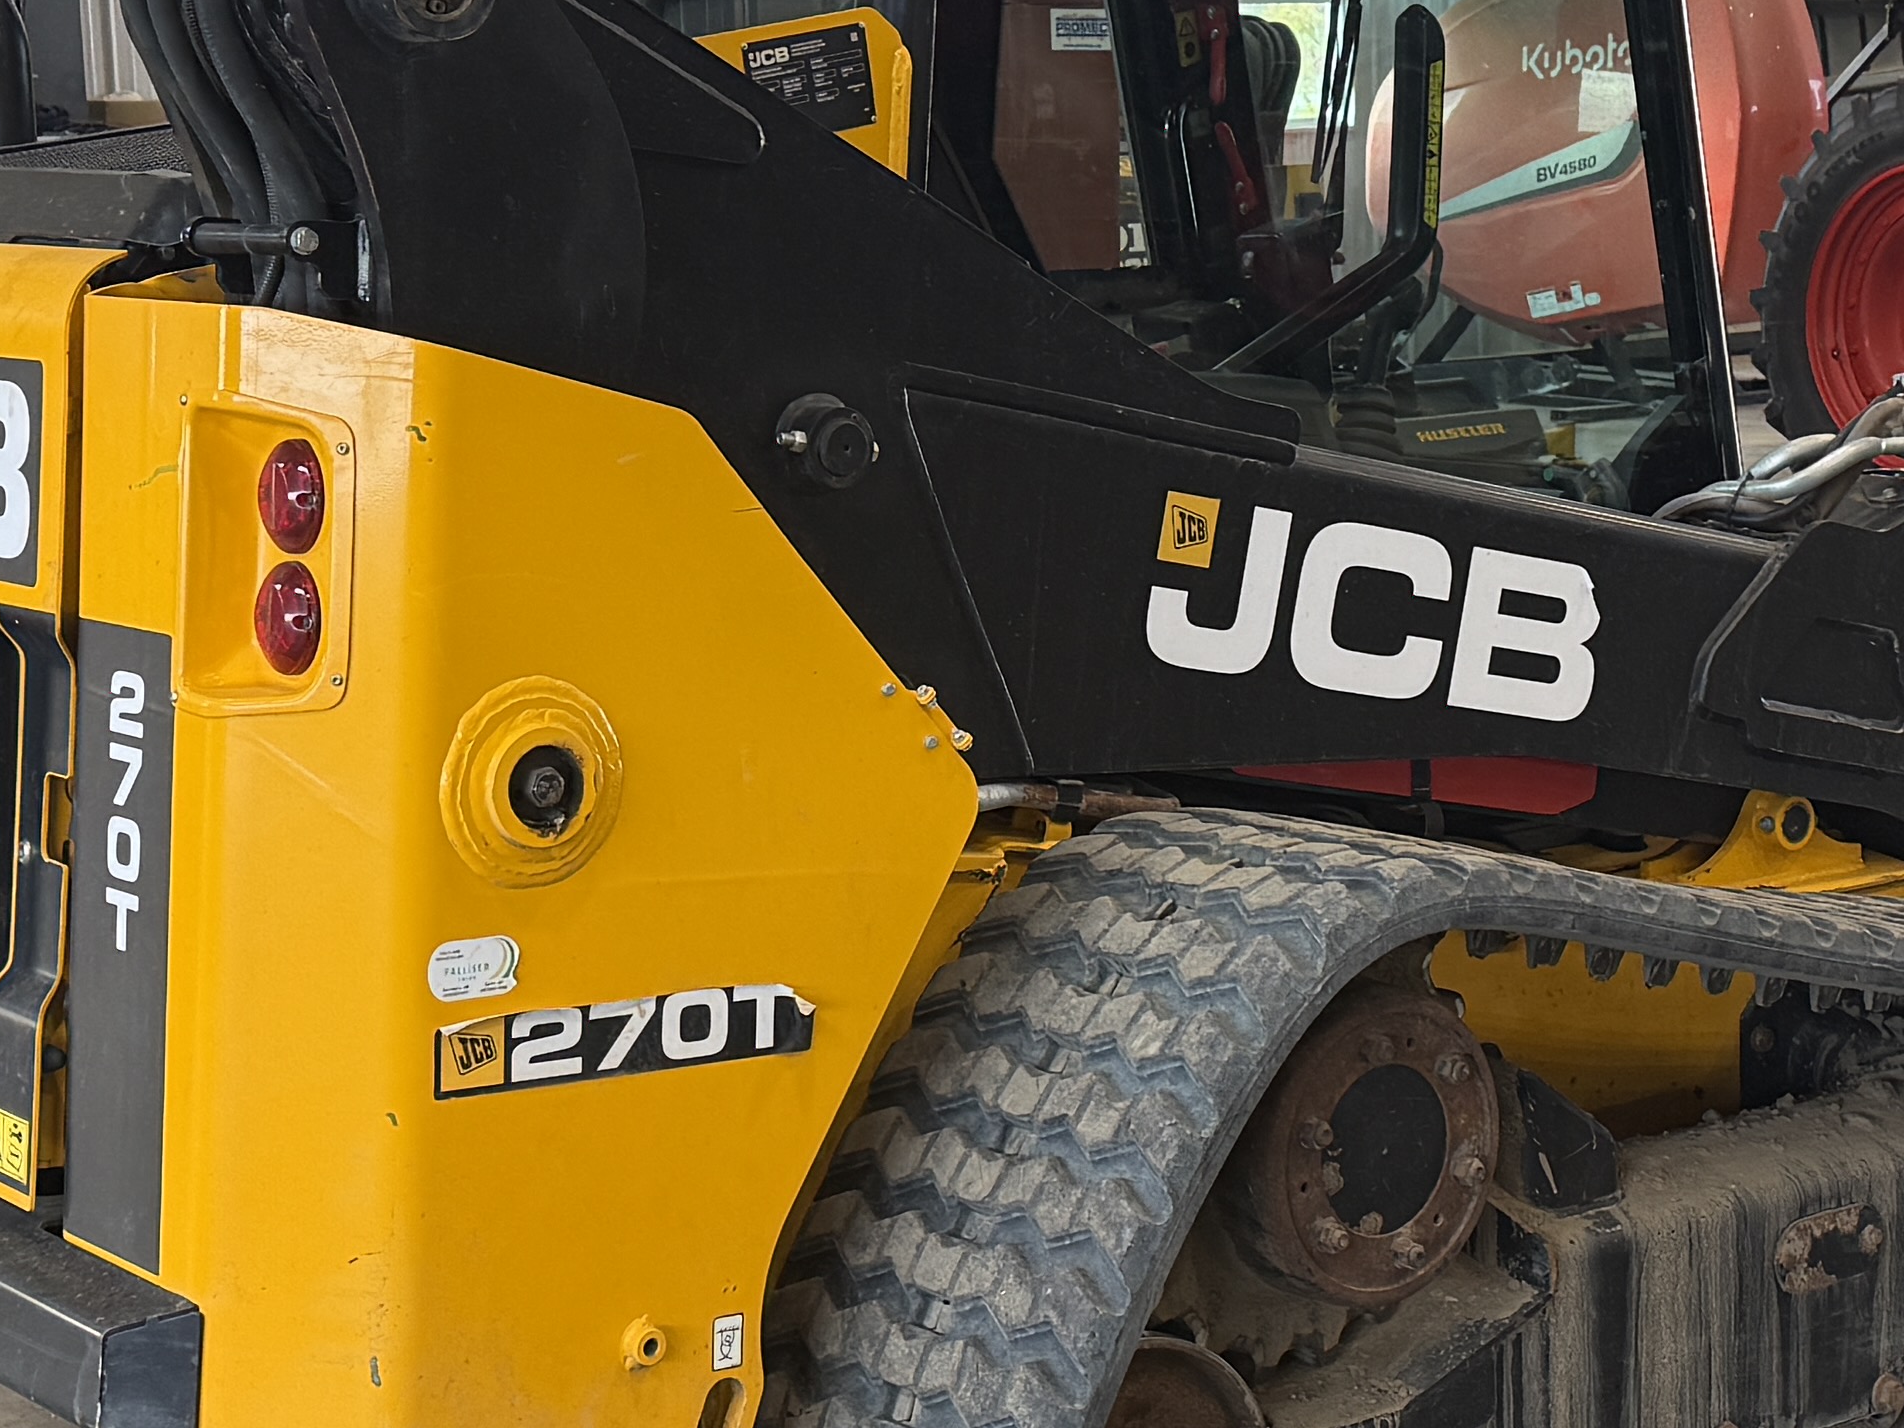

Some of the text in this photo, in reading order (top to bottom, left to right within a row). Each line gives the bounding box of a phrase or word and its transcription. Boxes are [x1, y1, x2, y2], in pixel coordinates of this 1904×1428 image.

[748, 47, 790, 68] JCB
[1536, 155, 1597, 183] BV4580
[1416, 423, 1506, 442] HUSTLER
[1176, 510, 1206, 545] JCB
[1146, 506, 1601, 722] JCB
[105, 670, 146, 952] 270T
[511, 983, 795, 1083] 270T
[458, 1036, 495, 1070] JCB
